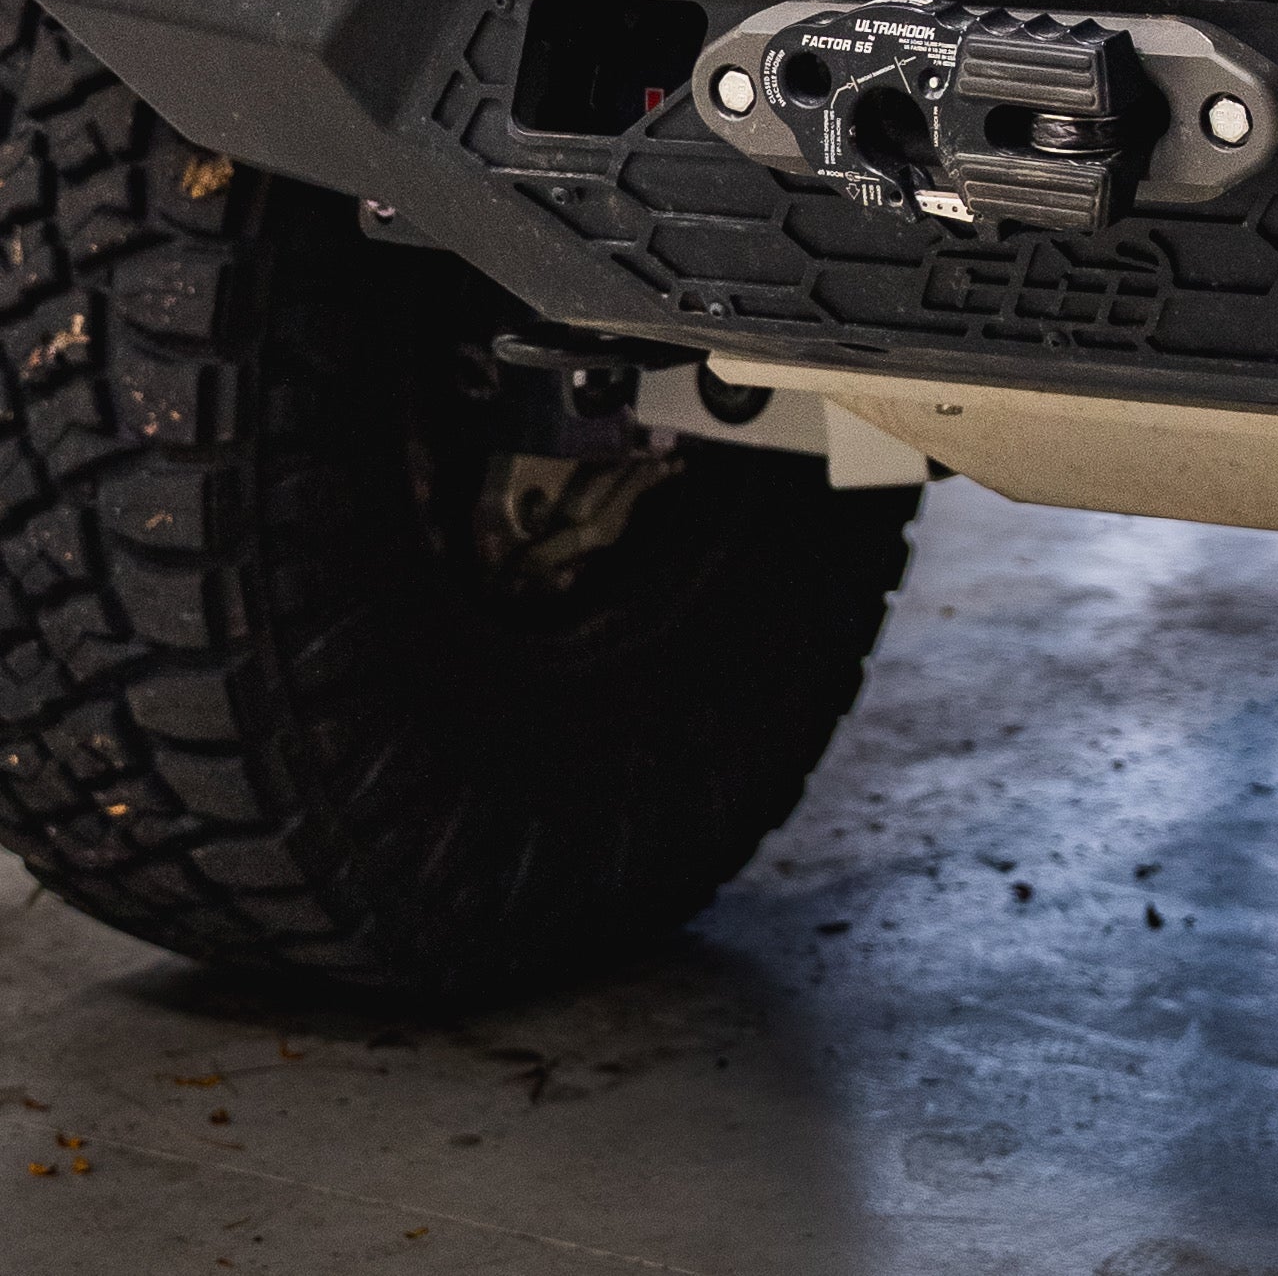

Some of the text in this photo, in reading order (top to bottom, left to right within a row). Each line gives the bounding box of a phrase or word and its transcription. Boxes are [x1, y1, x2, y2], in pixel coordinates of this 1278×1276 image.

[855, 19, 936, 39] ULTRAHOOK
[801, 34, 873, 53] FACTOR 55
[763, 75, 776, 105] CLOSED
